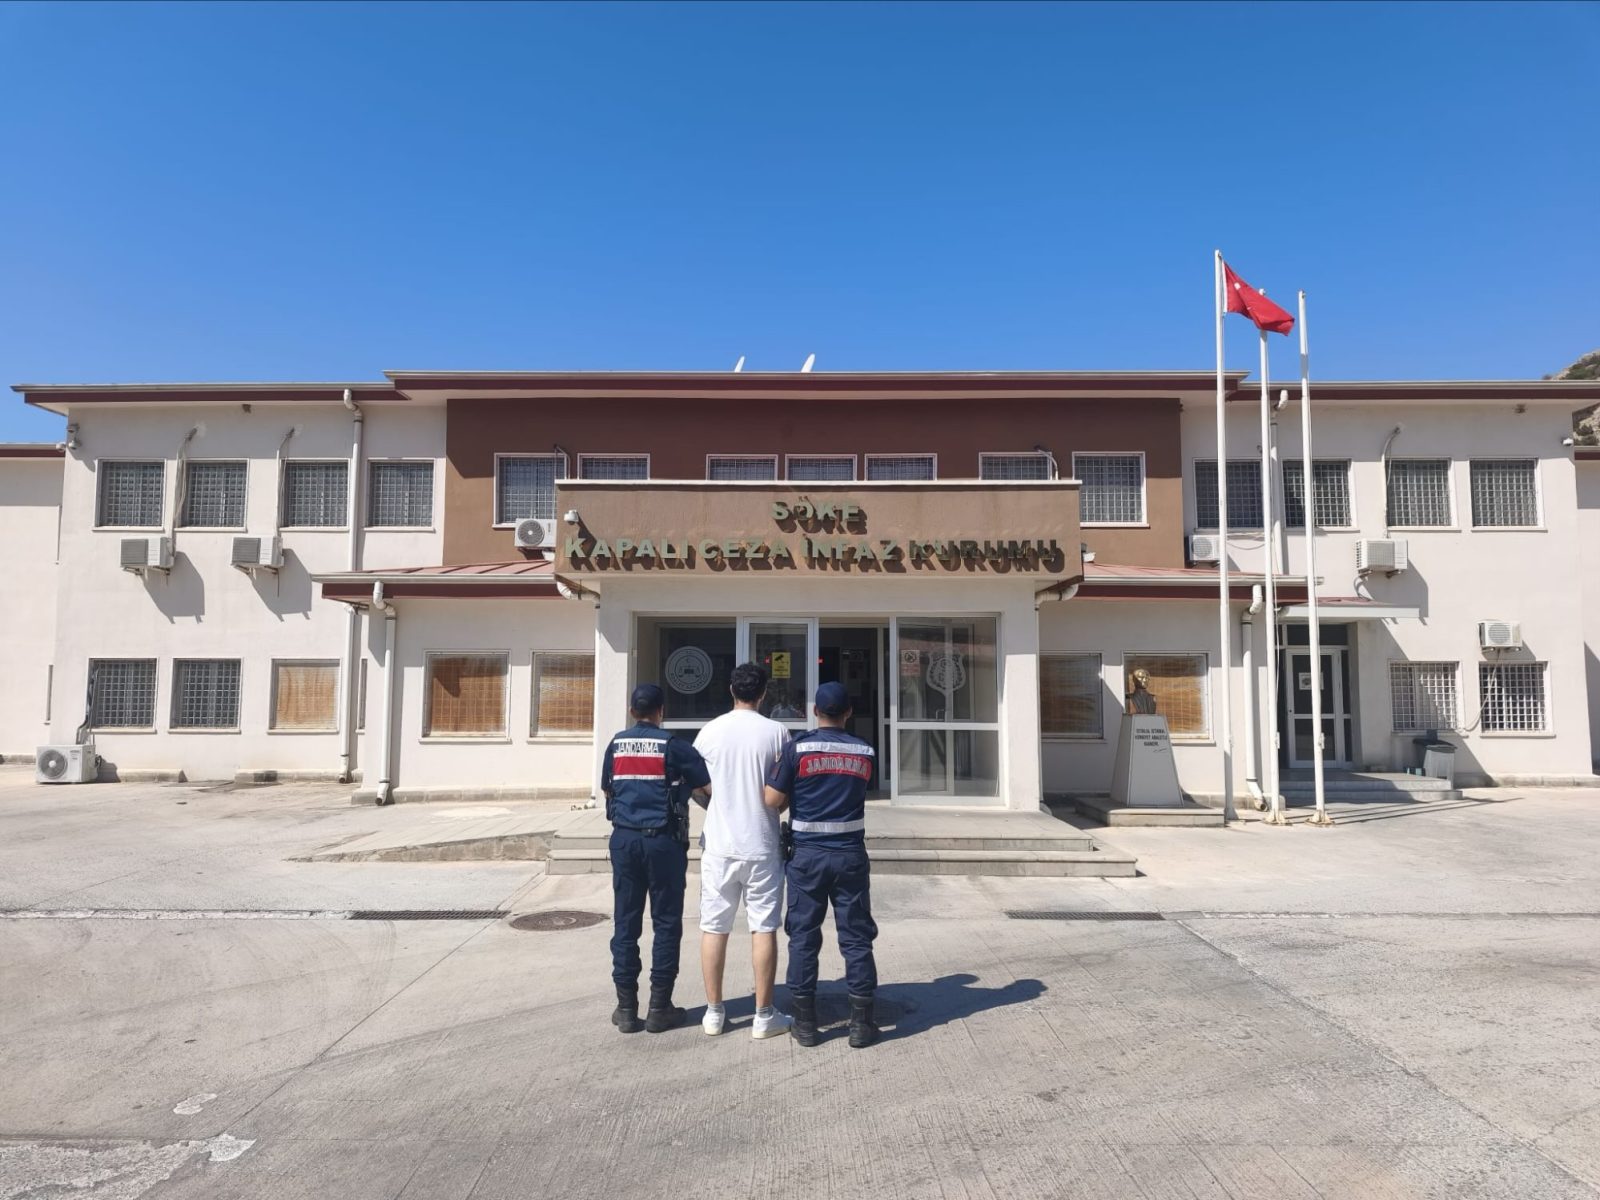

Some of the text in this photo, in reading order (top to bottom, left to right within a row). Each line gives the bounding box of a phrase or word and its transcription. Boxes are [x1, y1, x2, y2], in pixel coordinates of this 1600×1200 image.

[565, 534, 1058, 561] KAPALI CEZA İNFAZ KURUMU
[615, 741, 660, 754] JANDARMA
[806, 756, 868, 777] JANDARMA
